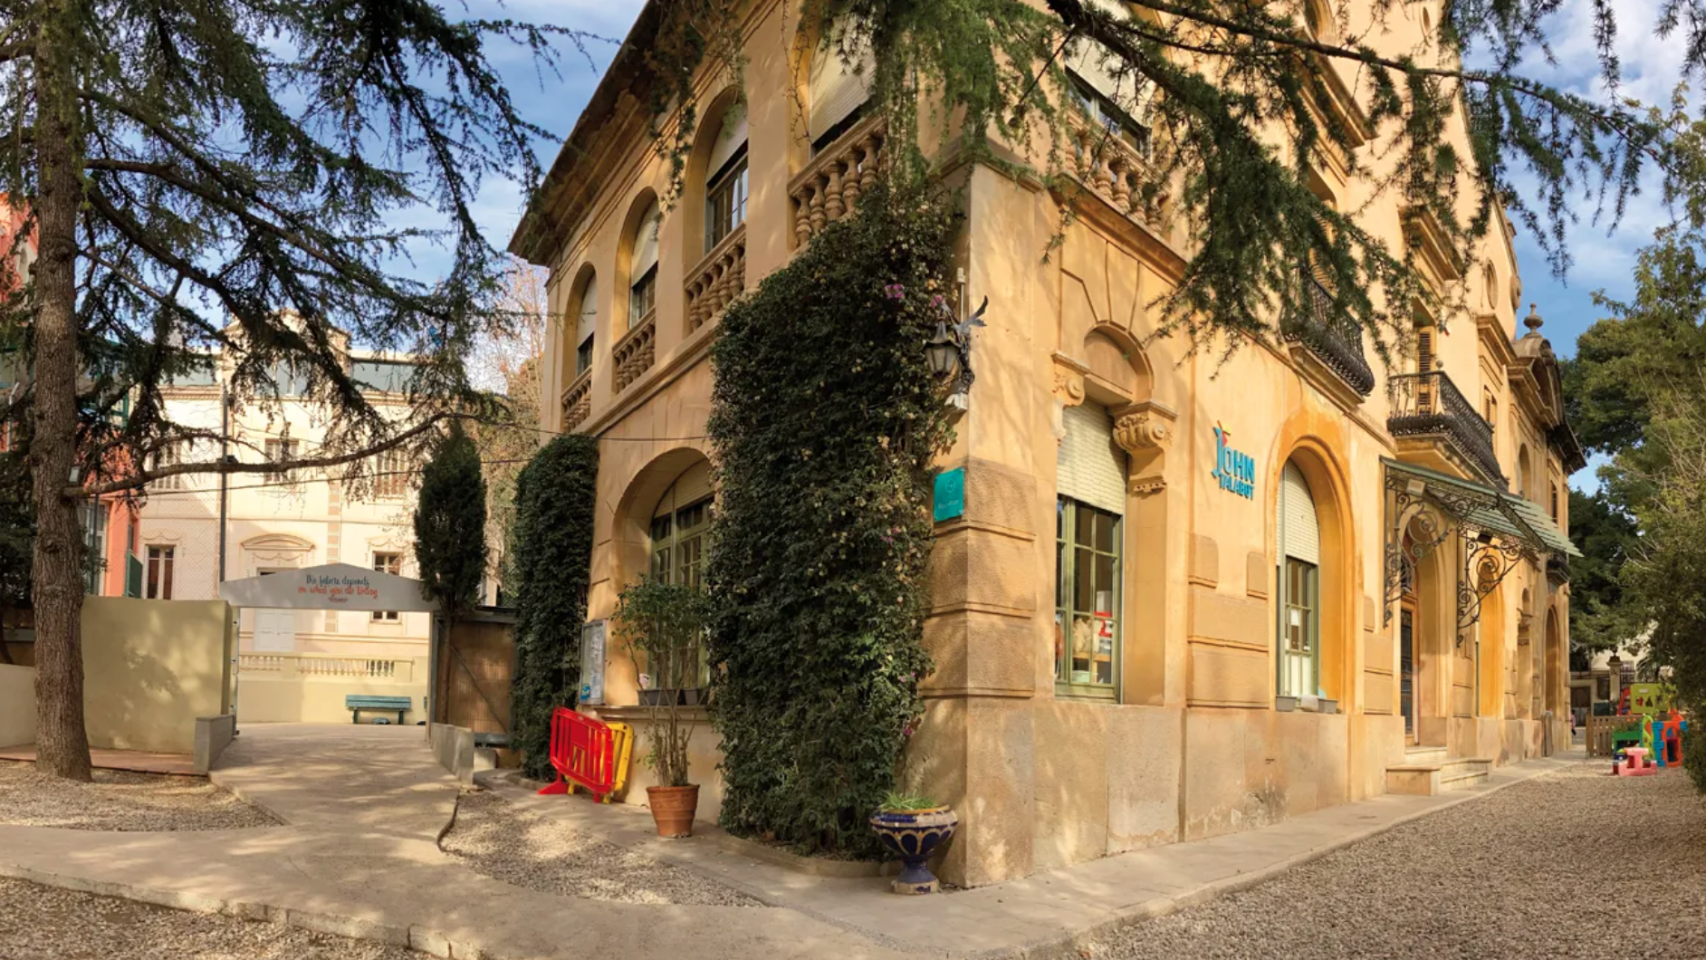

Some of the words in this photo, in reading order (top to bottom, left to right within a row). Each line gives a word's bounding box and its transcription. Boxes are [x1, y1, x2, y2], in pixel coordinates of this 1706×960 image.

[1211, 426, 1255, 484] JOHN
[310, 584, 328, 595] what
[330, 587, 342, 597] you
[357, 586, 378, 599] today
